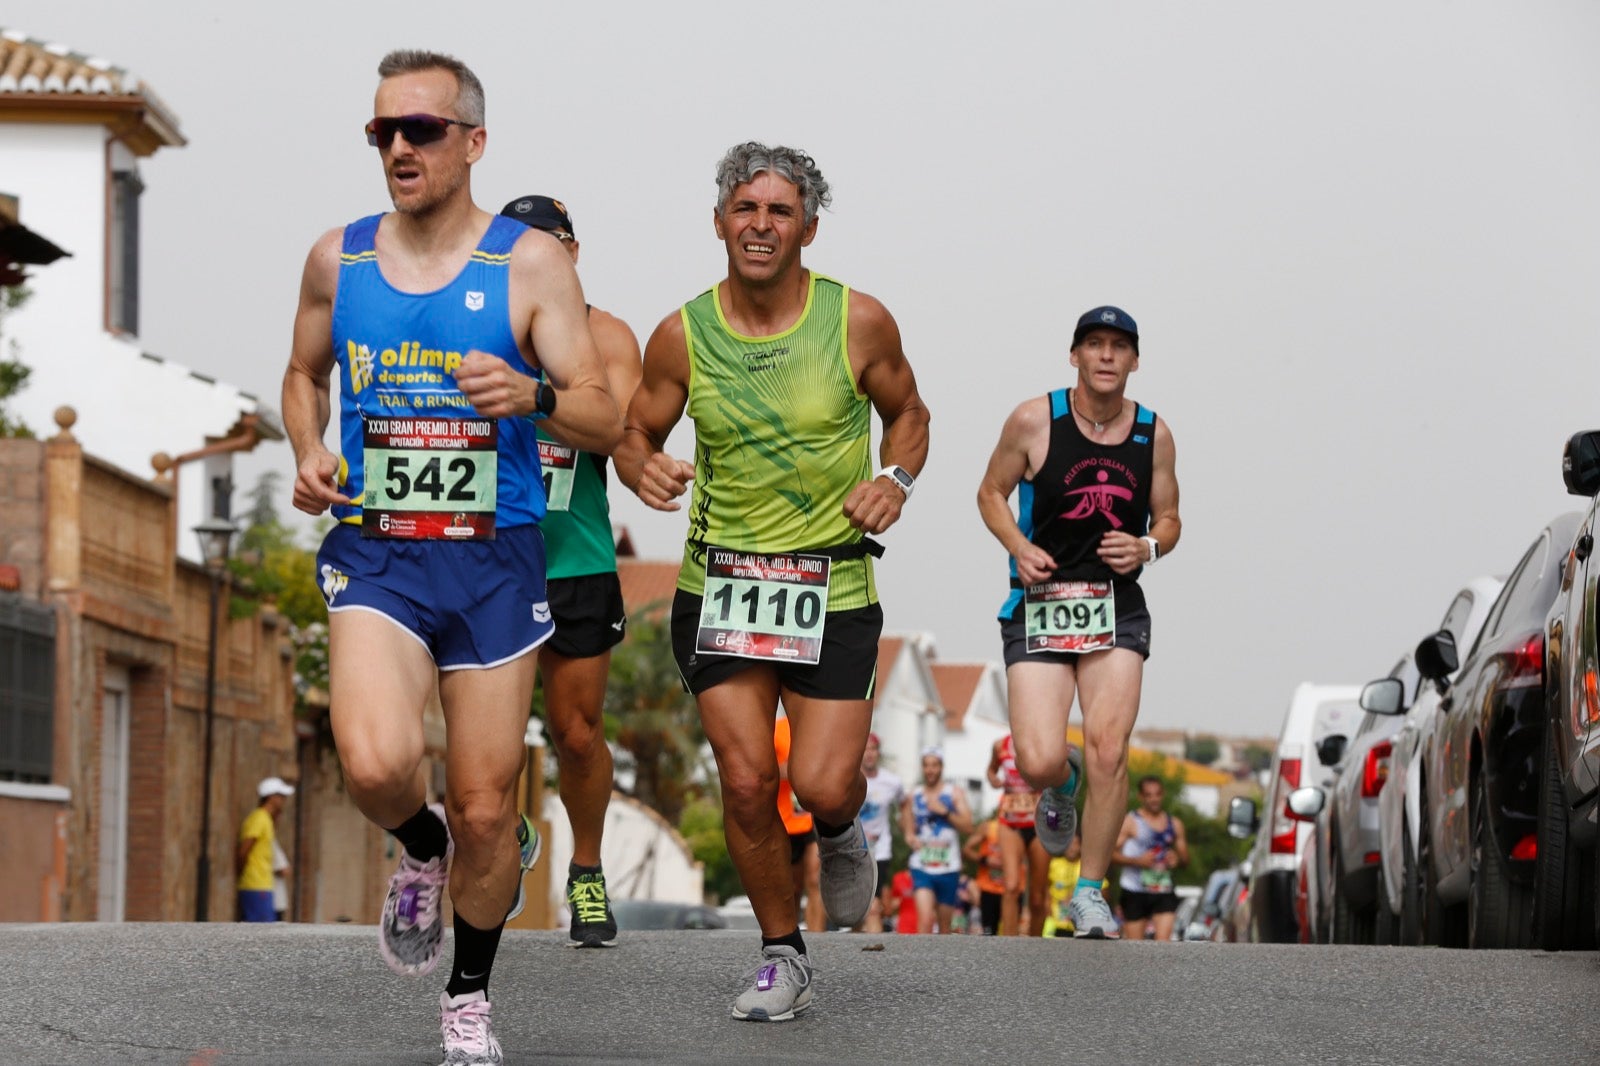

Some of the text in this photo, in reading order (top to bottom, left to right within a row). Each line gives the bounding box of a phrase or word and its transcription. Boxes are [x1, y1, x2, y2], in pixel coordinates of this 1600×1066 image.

[380, 341, 463, 375] olimp
[378, 369, 443, 386] deportes
[377, 394, 409, 407] TRAIL
[413, 395, 423, 408] &
[368, 419, 491, 437] XXXII GRAN PREMIO DE FONDO
[389, 436, 424, 447] DIPUTACIÓN
[429, 437, 469, 448] CRUZCAMPO
[540, 444, 571, 459] DE FONDO
[385, 456, 476, 501] 542
[714, 551, 734, 565] XXXII
[797, 559, 823, 574] FONDO
[713, 583, 821, 630] 1110
[1033, 602, 1107, 630] 1091
